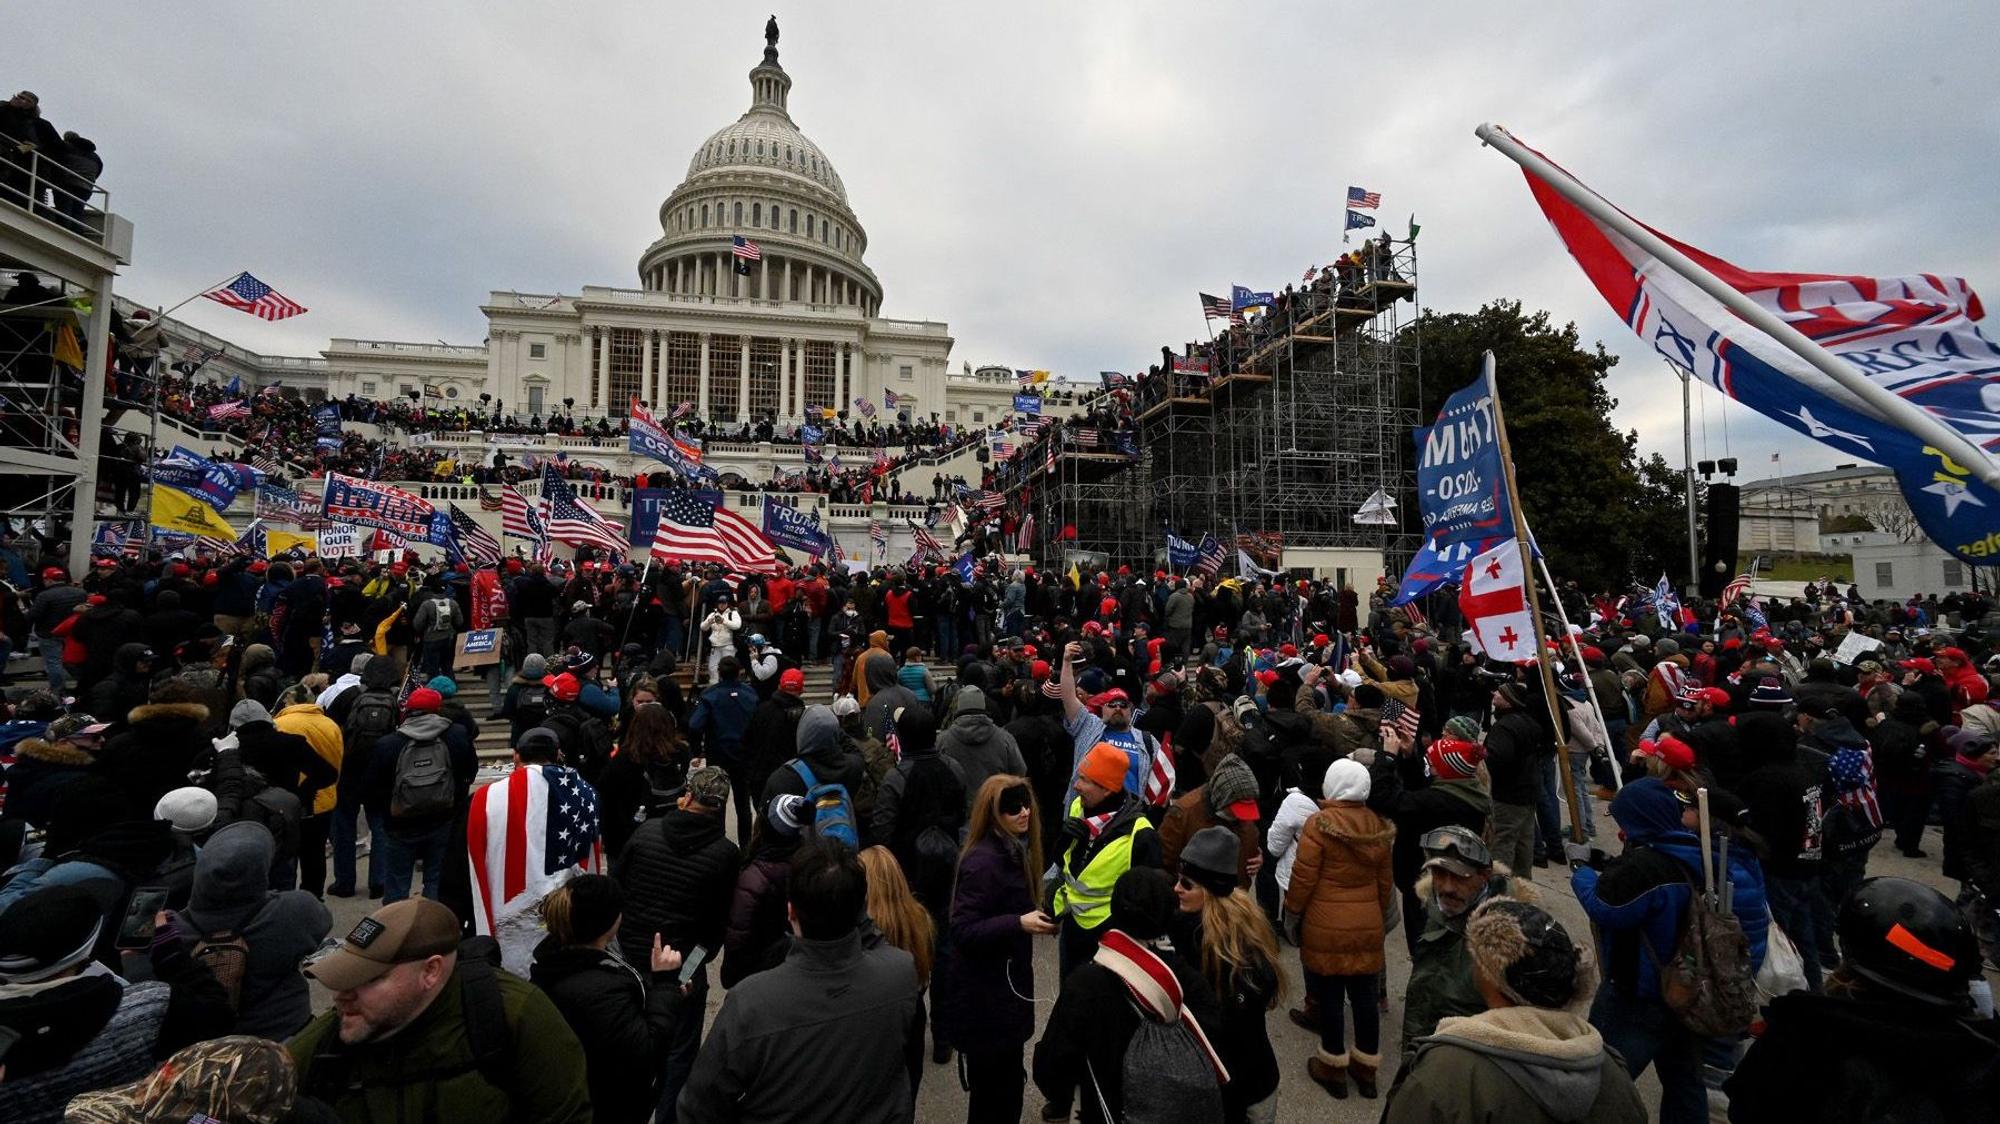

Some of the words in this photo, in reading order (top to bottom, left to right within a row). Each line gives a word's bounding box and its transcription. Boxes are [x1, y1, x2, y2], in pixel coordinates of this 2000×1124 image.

[264, 492, 321, 514] TRUM
[324, 535, 352, 545] OUR
[321, 545, 356, 556] VOTE
